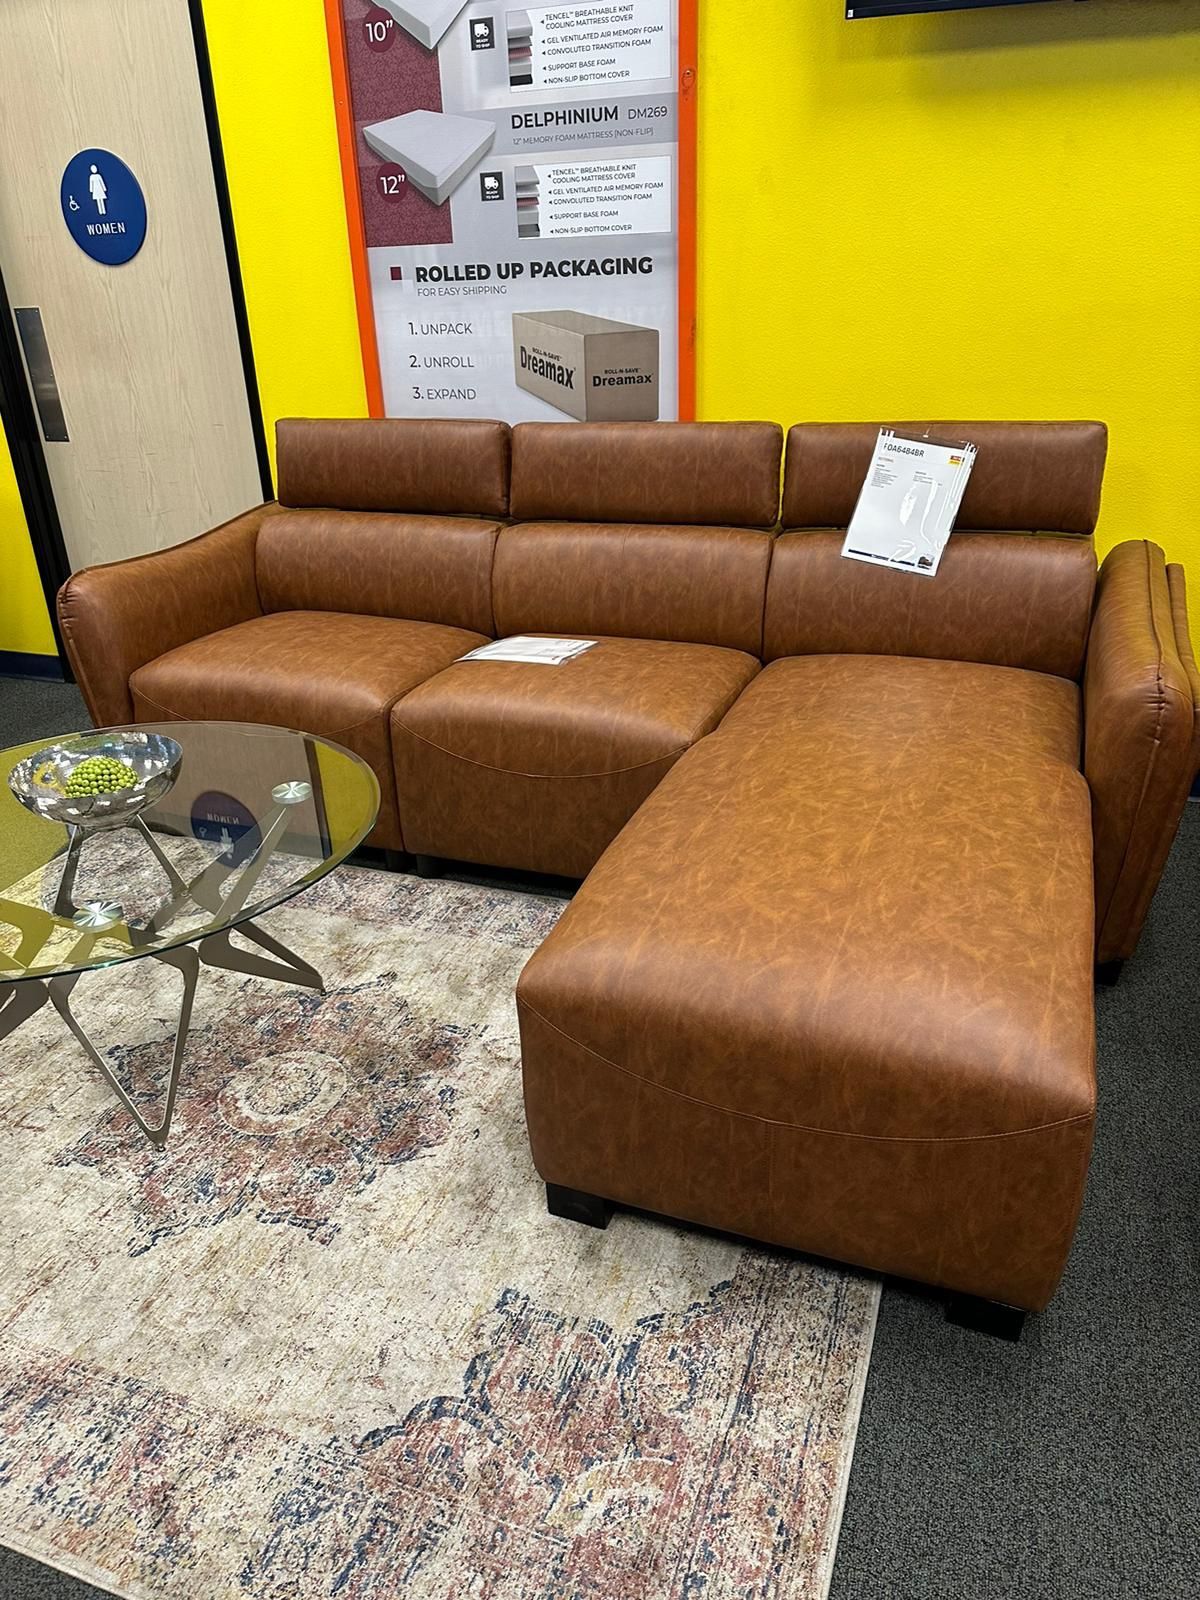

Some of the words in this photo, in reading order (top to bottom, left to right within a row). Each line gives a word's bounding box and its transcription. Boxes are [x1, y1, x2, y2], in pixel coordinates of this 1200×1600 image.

[575, 6, 617, 18] BREATHABLE
[619, 4, 634, 12] KNIT
[545, 20, 575, 30] COOLING
[576, 16, 610, 26] MATTRESS
[610, 14, 633, 23] COVER
[561, 32, 599, 43] VENTILATED
[600, 30, 611, 38] AIR
[613, 27, 642, 37] MEMORY
[643, 25, 663, 34] FOAM
[547, 45, 591, 56] CONVOLUTED
[592, 41, 630, 51] TRANSITION
[632, 38, 651, 47] FOAM
[548, 62, 577, 72] SUPPORT
[579, 60, 595, 68] BASE
[597, 58, 616, 66] FOAM
[548, 75, 578, 84] NON-SLIP
[580, 72, 606, 82] BOTTOM
[607, 70, 630, 79] COVER
[511, 105, 618, 130] DELPHINIUM
[628, 105, 668, 120] DM269
[523, 135, 553, 145] MEMORY
[555, 133, 576, 142] FOAM
[577, 130, 614, 140] MATTRESS
[580, 164, 620, 174] BREATHABLE
[552, 176, 581, 184] COOLING
[582, 173, 613, 182] MATTRESS
[566, 185, 602, 194] VENTILATED
[615, 183, 643, 191] MEMORY
[553, 197, 595, 205] CONVOLUTED
[596, 194, 632, 202] TRANSITION
[554, 212, 582, 220] SUPPORT
[583, 210, 599, 218] BASE
[86, 222, 126, 236] WOMEN
[584, 225, 610, 233] BOTTOM
[415, 263, 491, 283] ROLLED
[496, 262, 524, 280] UP
[530, 256, 653, 279] PACKAGING
[417, 287, 436, 297] FOR
[438, 286, 461, 297] EASY
[463, 284, 507, 297] SHIPPING
[408, 322, 418, 335] 1.
[420, 322, 473, 335] UNPACK
[409, 355, 421, 368] 2.
[423, 356, 475, 368] UNROLL
[412, 386, 424, 400] 3.
[426, 388, 477, 400] EXPAND
